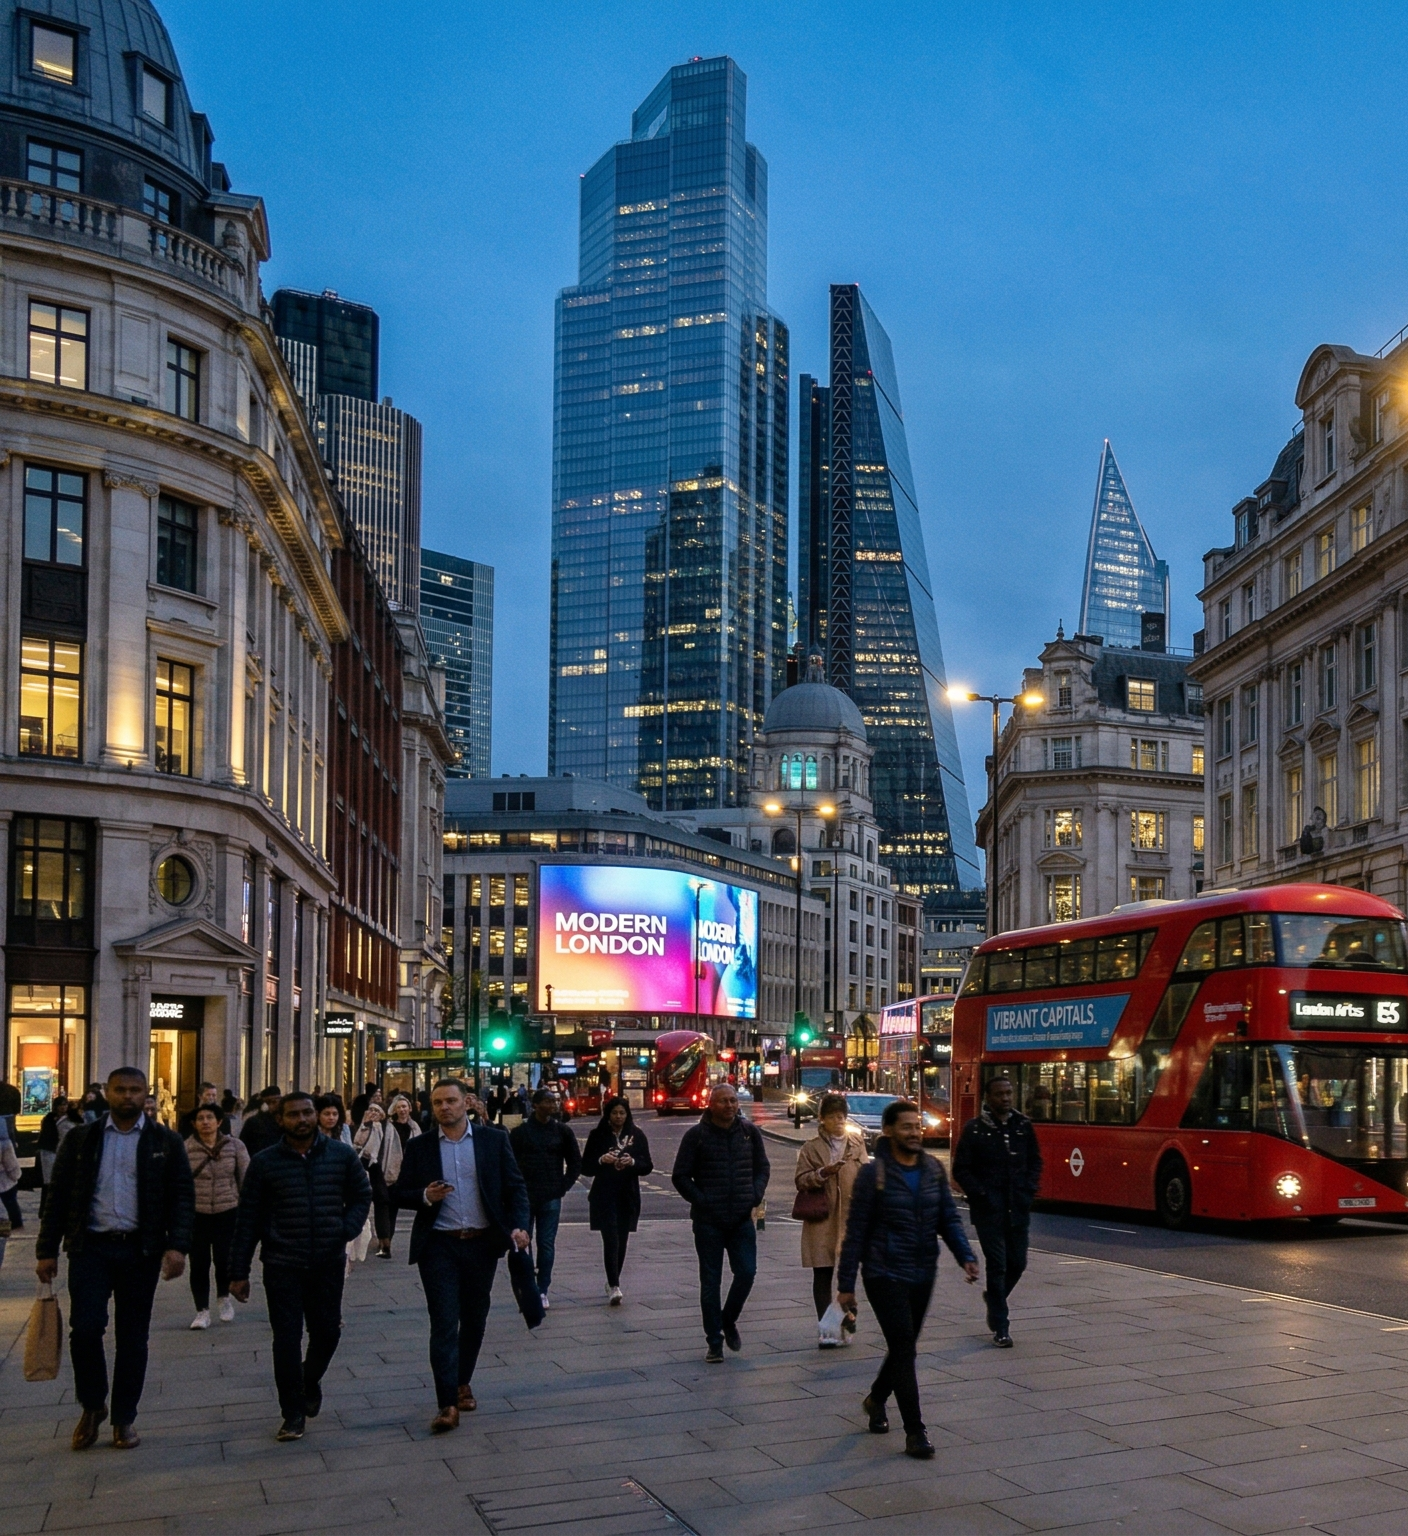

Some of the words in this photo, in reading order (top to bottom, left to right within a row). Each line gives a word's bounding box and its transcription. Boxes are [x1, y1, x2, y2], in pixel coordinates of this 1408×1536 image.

[555, 912, 667, 935] MODERN
[555, 934, 665, 956] LONDON
[1040, 1003, 1097, 1028] CAPITALS.
